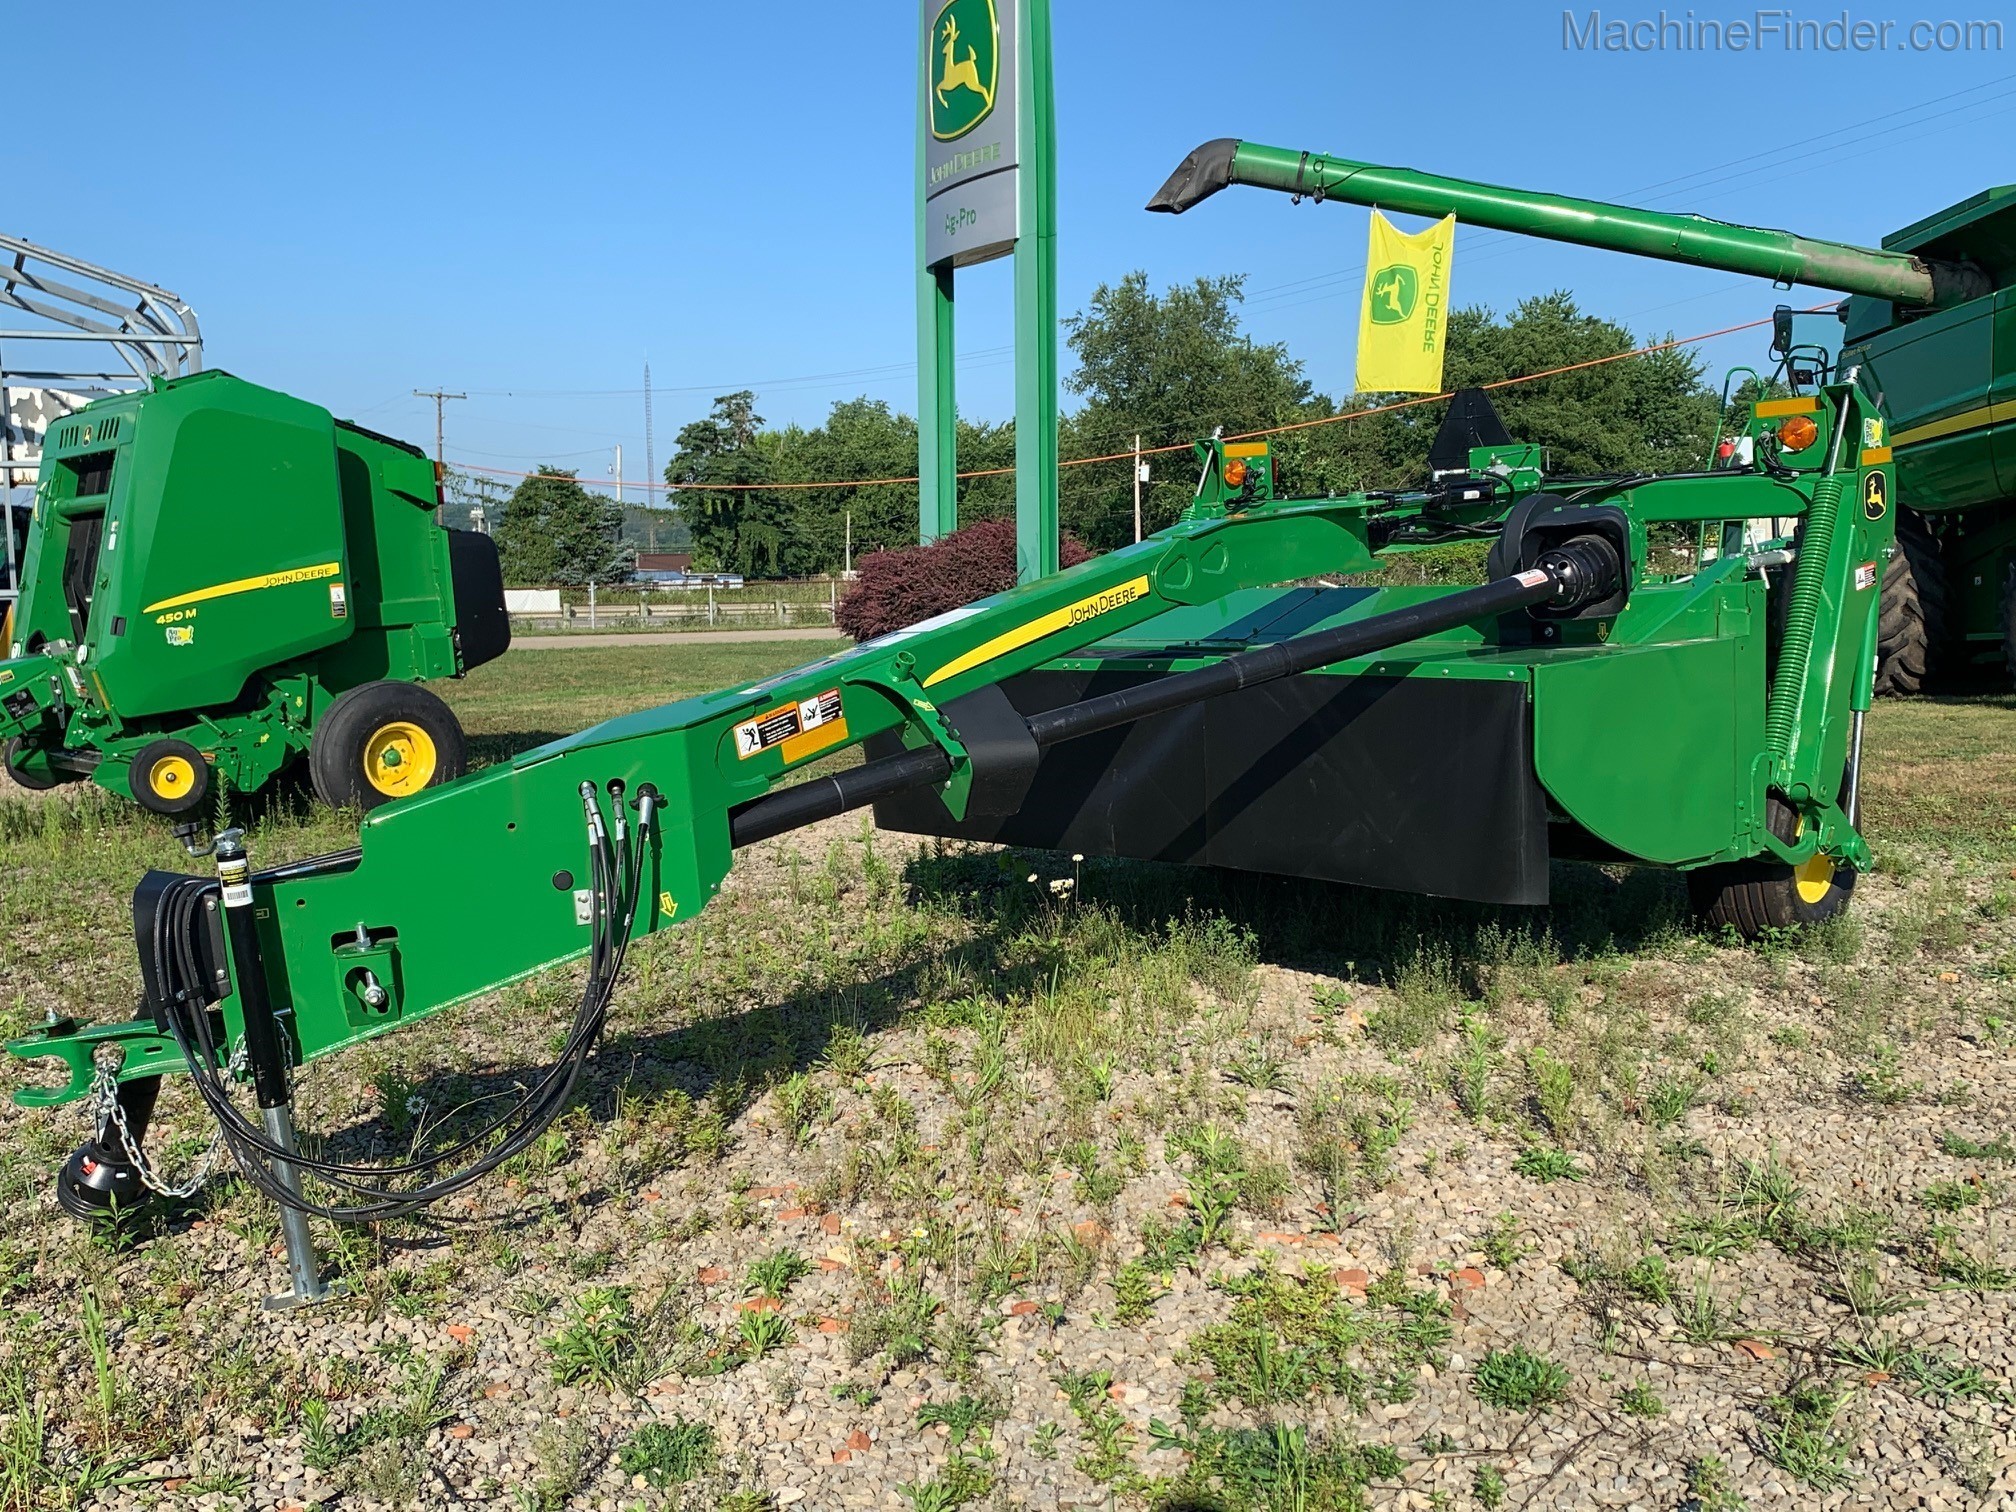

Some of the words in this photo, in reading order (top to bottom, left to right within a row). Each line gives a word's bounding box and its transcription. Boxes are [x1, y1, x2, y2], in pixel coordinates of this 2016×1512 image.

[929, 160, 954, 187] JOHN
[954, 141, 1001, 174] DEERE
[944, 207, 977, 236] Ag-Pro
[263, 574, 293, 587] JOHN
[295, 567, 333, 581] DEERE
[156, 611, 184, 624] 450
[185, 608, 197, 619] M
[1068, 601, 1099, 625] JOHN
[1099, 586, 1137, 612] DEERE
